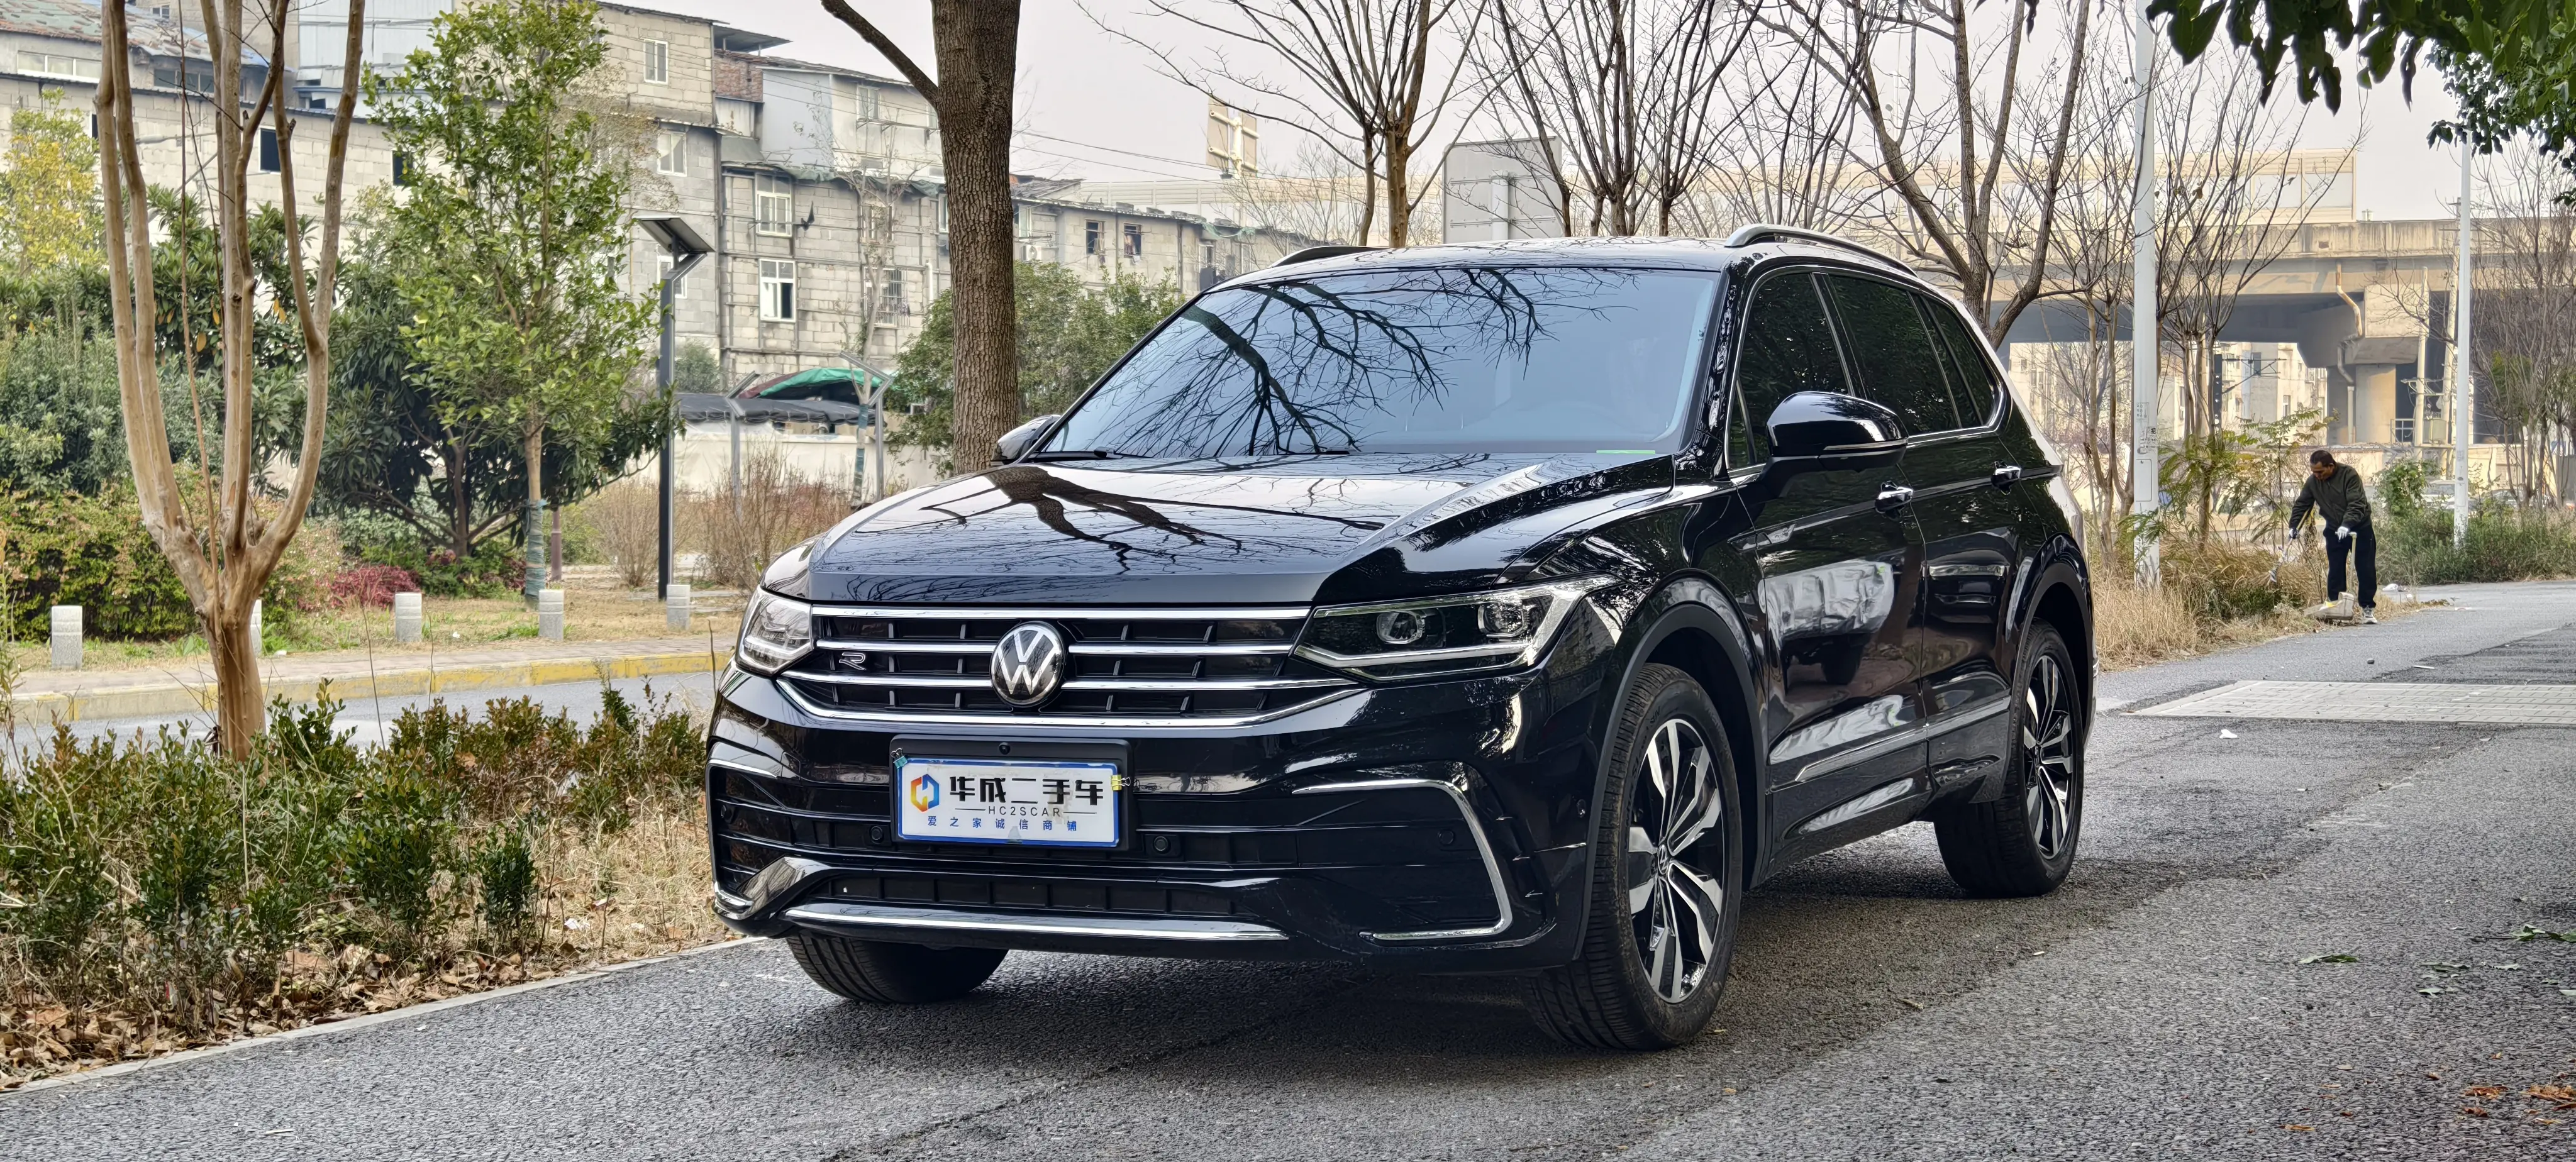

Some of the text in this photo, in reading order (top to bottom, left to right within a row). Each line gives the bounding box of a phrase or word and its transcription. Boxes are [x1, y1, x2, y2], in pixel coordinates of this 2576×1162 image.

[838, 652, 866, 671] R
[949, 775, 1104, 806] 华成二手车
[988, 805, 1061, 817] HC2SCAR
